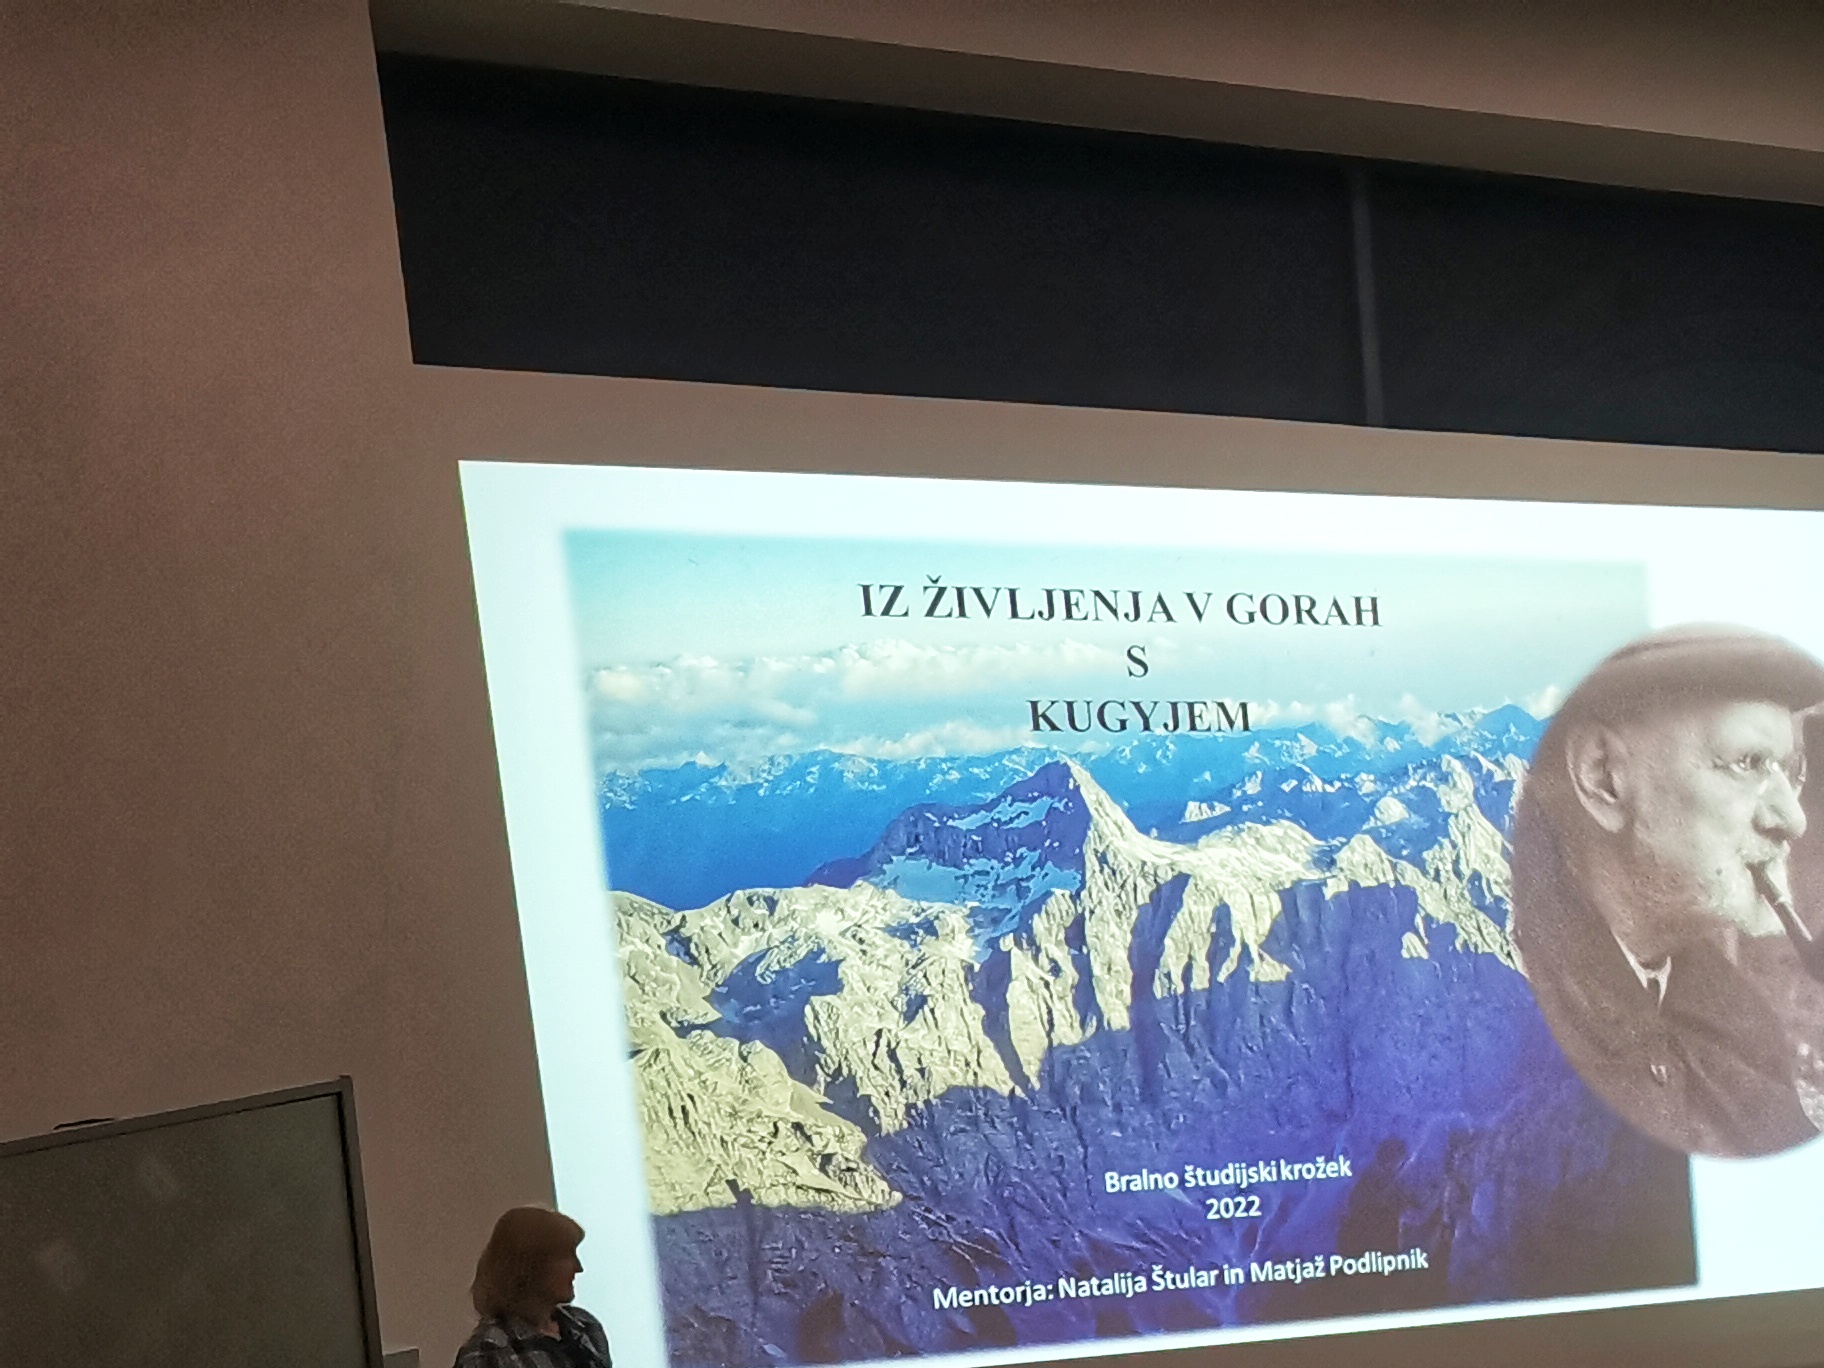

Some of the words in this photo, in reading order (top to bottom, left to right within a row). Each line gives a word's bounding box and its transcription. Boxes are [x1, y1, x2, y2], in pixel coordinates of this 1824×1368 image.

[858, 583, 909, 618] IZ
[923, 575, 1179, 623] ŽIVLJENJA
[1185, 591, 1213, 624] V
[1226, 592, 1382, 627] GORAH
[1126, 645, 1150, 678] S
[1026, 699, 1252, 734] KUGYJEM
[1104, 1168, 1179, 1194] Bralno
[1184, 1160, 1278, 1189] študijski
[1279, 1154, 1353, 1182] krožek
[1205, 1195, 1262, 1220] 2022
[932, 1279, 1054, 1310] Mentorja:
[1057, 1271, 1148, 1299] Natalija
[1151, 1264, 1220, 1291] Štular
[1222, 1263, 1245, 1285] in
[1249, 1254, 1327, 1285] Matjaž
[1329, 1246, 1430, 1277] Podlipnik
